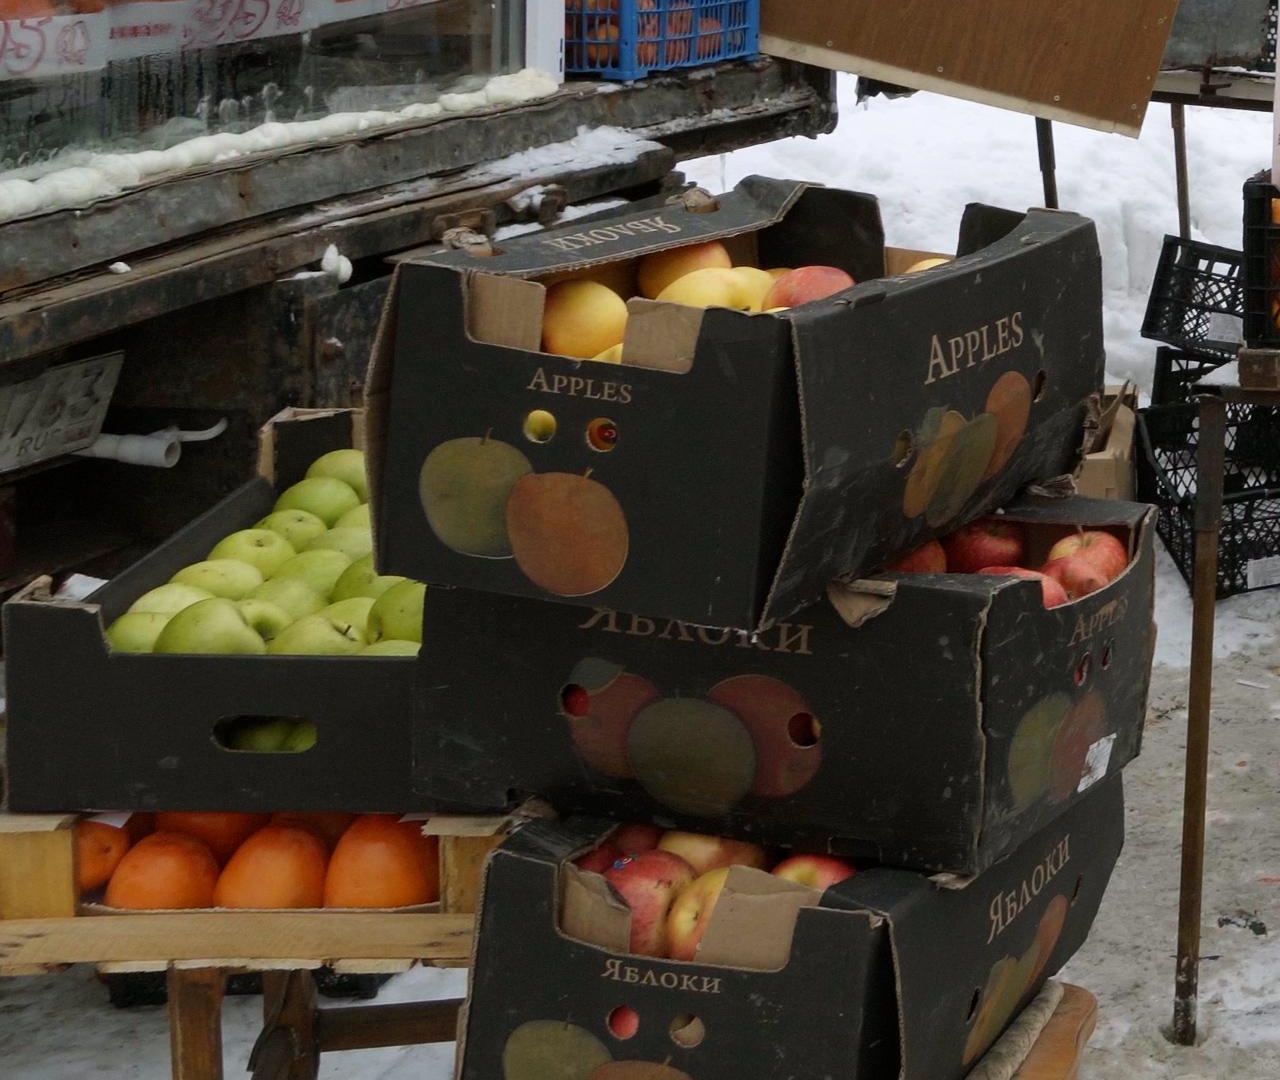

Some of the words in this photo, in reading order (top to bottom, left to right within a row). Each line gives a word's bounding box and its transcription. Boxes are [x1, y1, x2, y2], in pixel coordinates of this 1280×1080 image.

[541, 216, 682, 251] ЯБЛОКИ
[987, 832, 1071, 945] ЯБЛОКИ
[600, 958, 722, 994] ЯБЛОКИ
